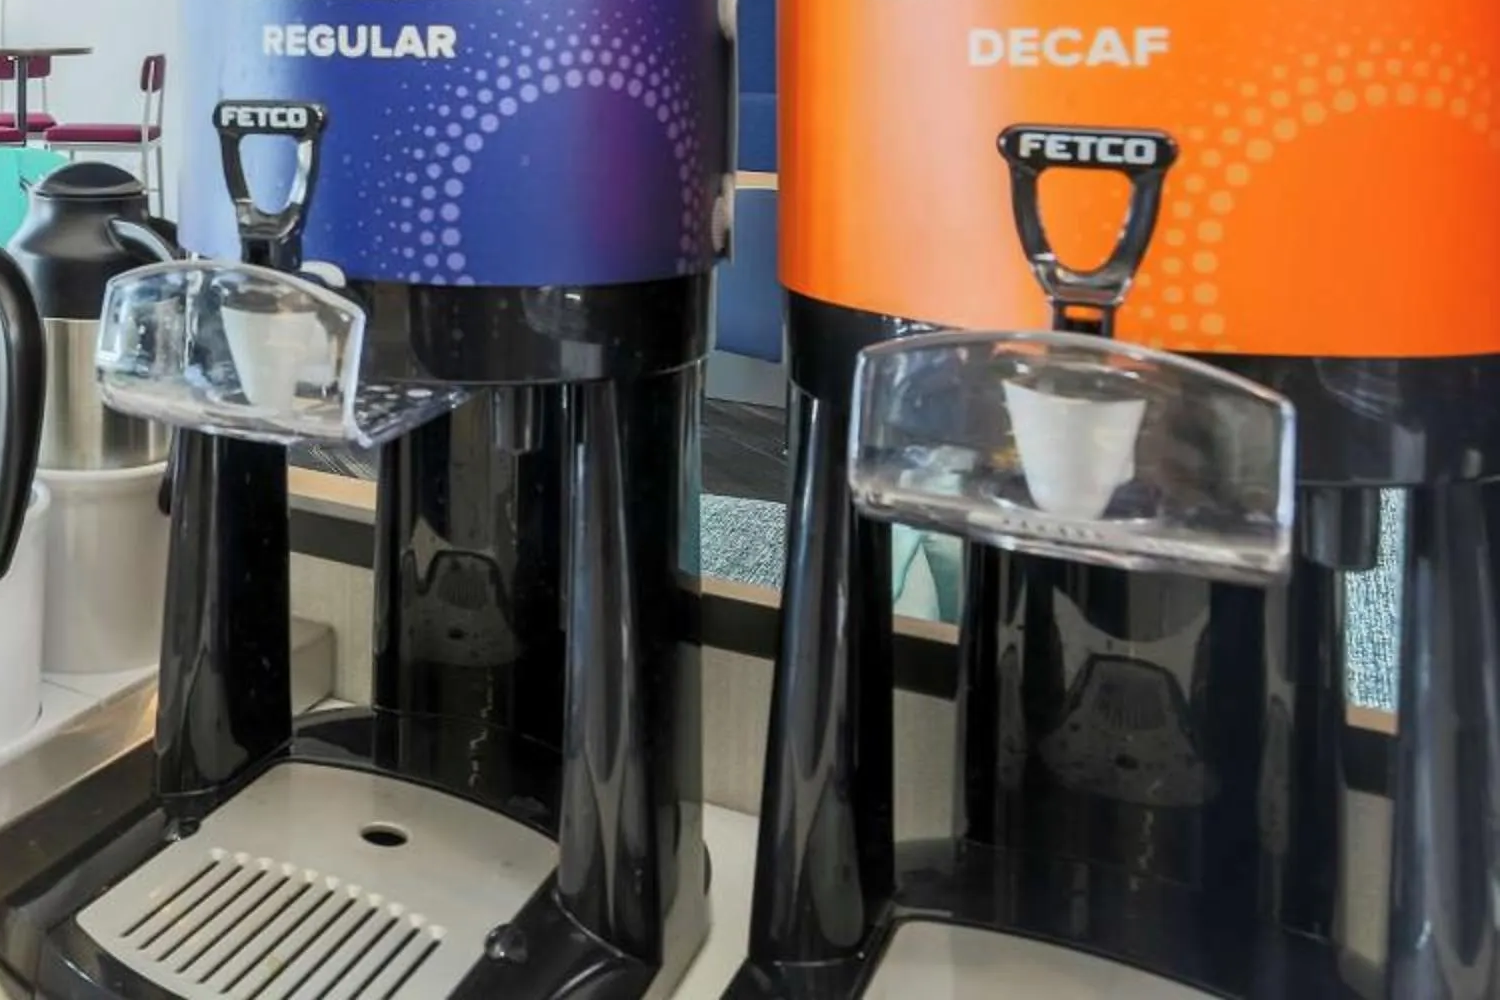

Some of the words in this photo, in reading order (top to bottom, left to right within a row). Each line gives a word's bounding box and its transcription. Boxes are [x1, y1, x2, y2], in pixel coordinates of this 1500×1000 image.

[262, 24, 457, 58] REGULAR
[967, 27, 1171, 67] DECAF
[219, 105, 308, 129] FETCO
[1018, 132, 1157, 165] FETCO
